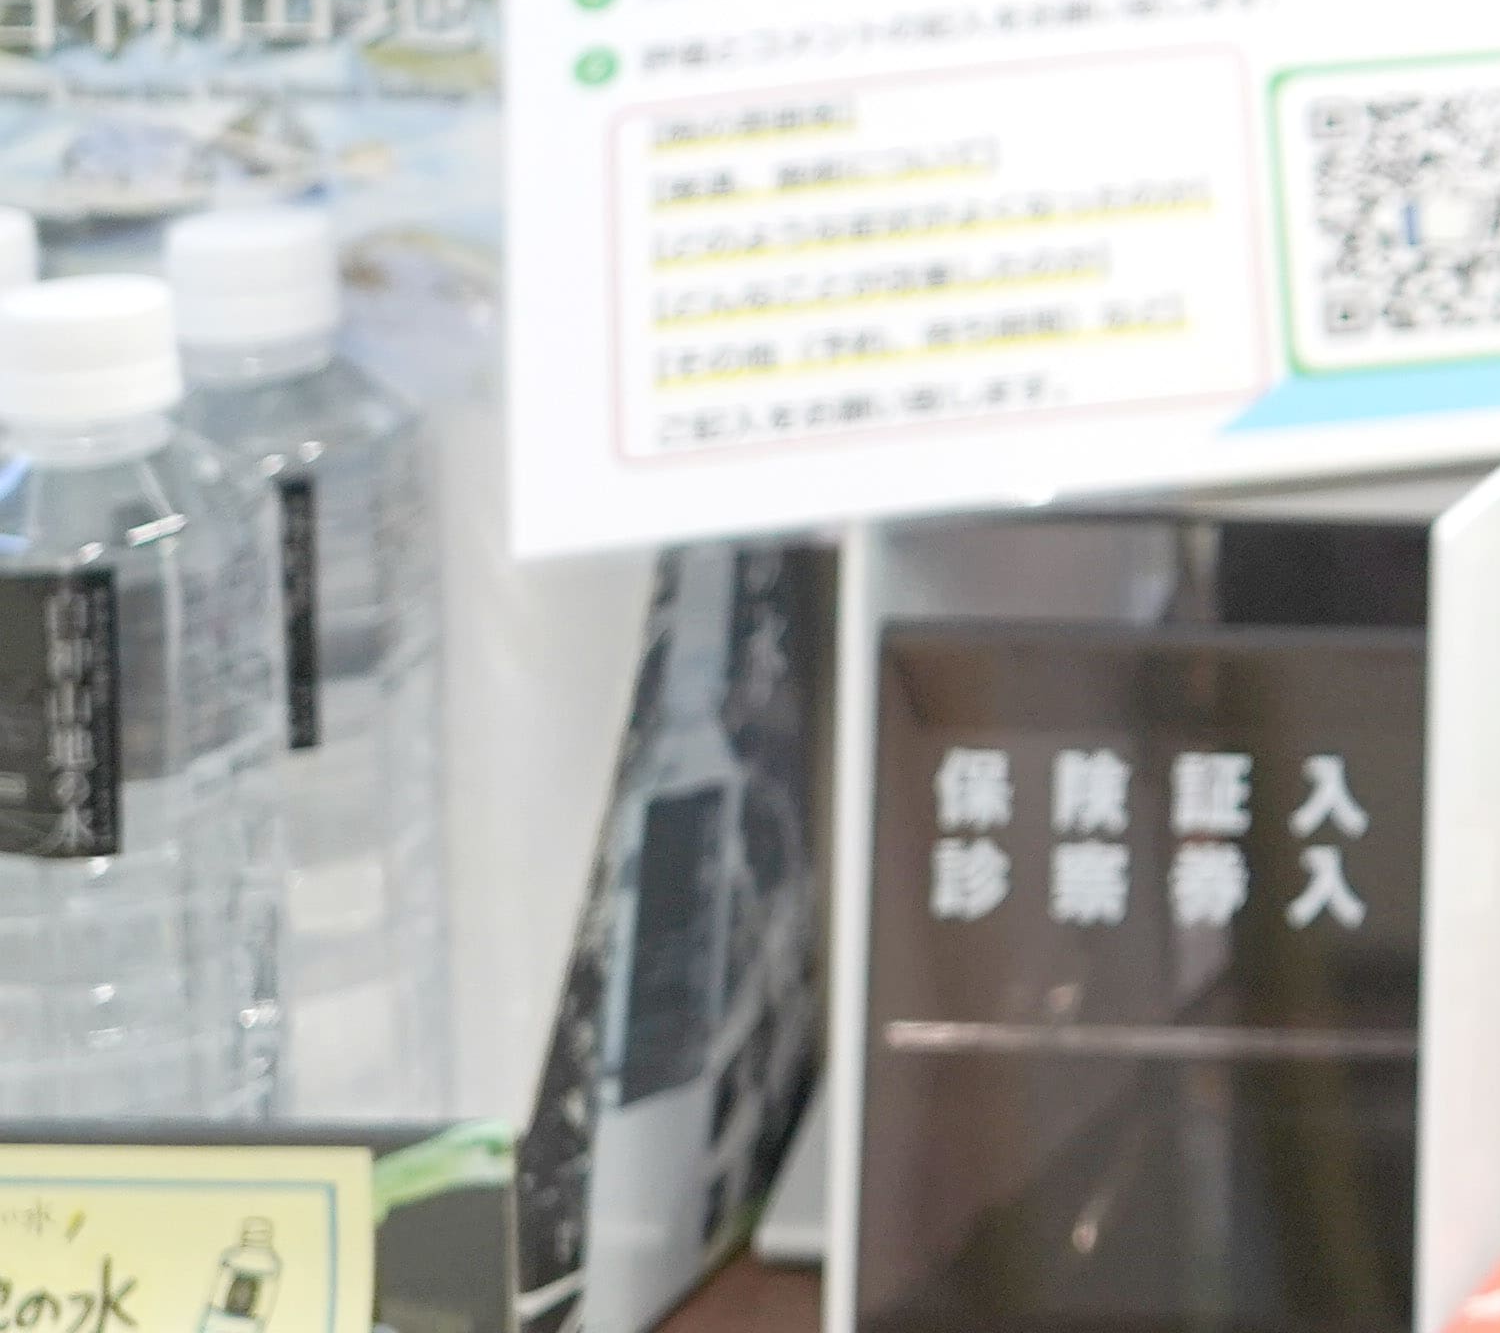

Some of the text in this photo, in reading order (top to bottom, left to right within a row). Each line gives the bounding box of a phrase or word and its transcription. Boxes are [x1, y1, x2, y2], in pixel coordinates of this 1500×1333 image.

[932, 745, 1370, 839] 保険証入
[928, 835, 1368, 929] 診察券入
[0, 1251, 139, 1333] の水
